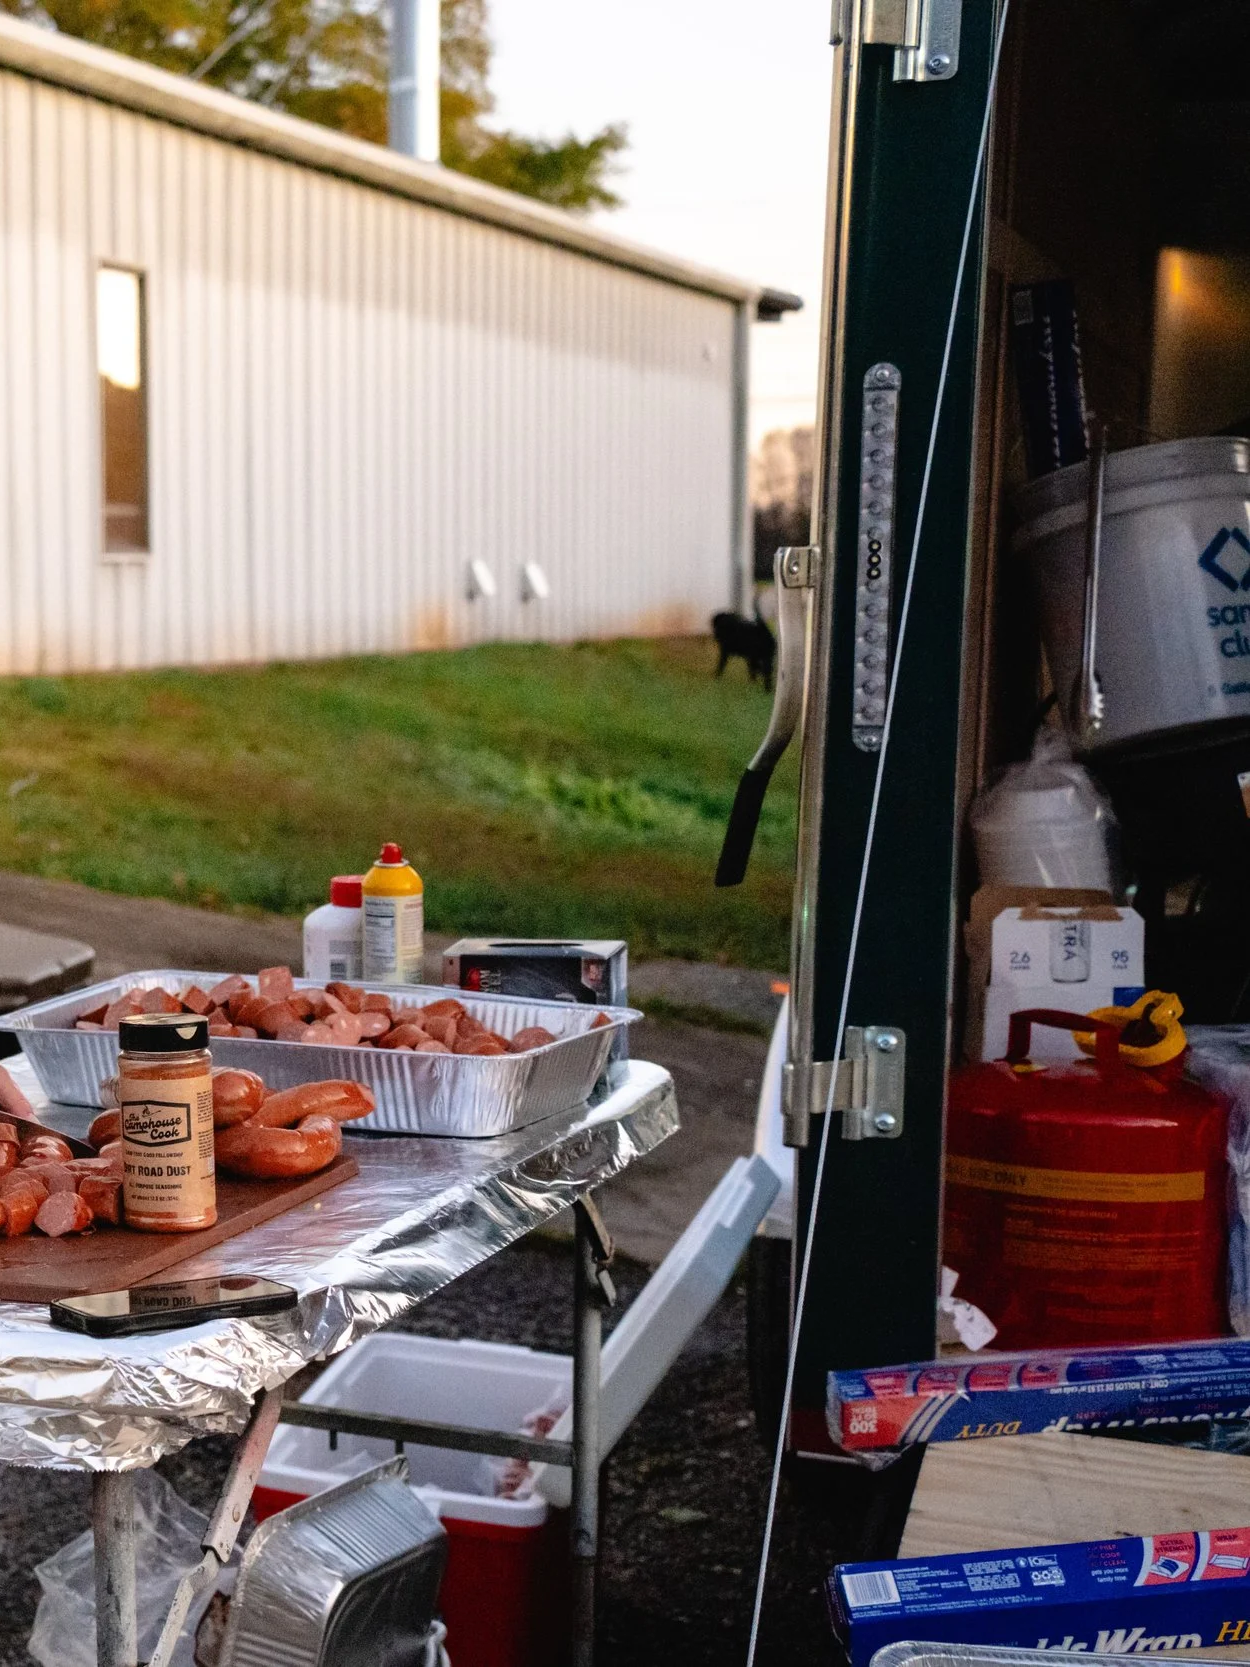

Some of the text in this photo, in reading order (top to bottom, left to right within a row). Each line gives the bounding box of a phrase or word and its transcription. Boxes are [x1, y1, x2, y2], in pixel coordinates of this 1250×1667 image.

[1062, 924, 1078, 962] TRA
[1111, 950, 1129, 964] 95
[124, 1116, 182, 1132] Camphouse
[150, 1127, 180, 1140] Cook
[138, 1165, 163, 1177] ROAD
[166, 1165, 192, 1177] DUST
[1104, 1383, 1114, 1392] DE
[1114, 1381, 1141, 1391] ROLLOS
[848, 1420, 878, 1434] 300
[954, 1420, 1022, 1440] DUTY
[1154, 1544, 1194, 1553] STRENGTH
[1093, 1626, 1202, 1653] Wrap
